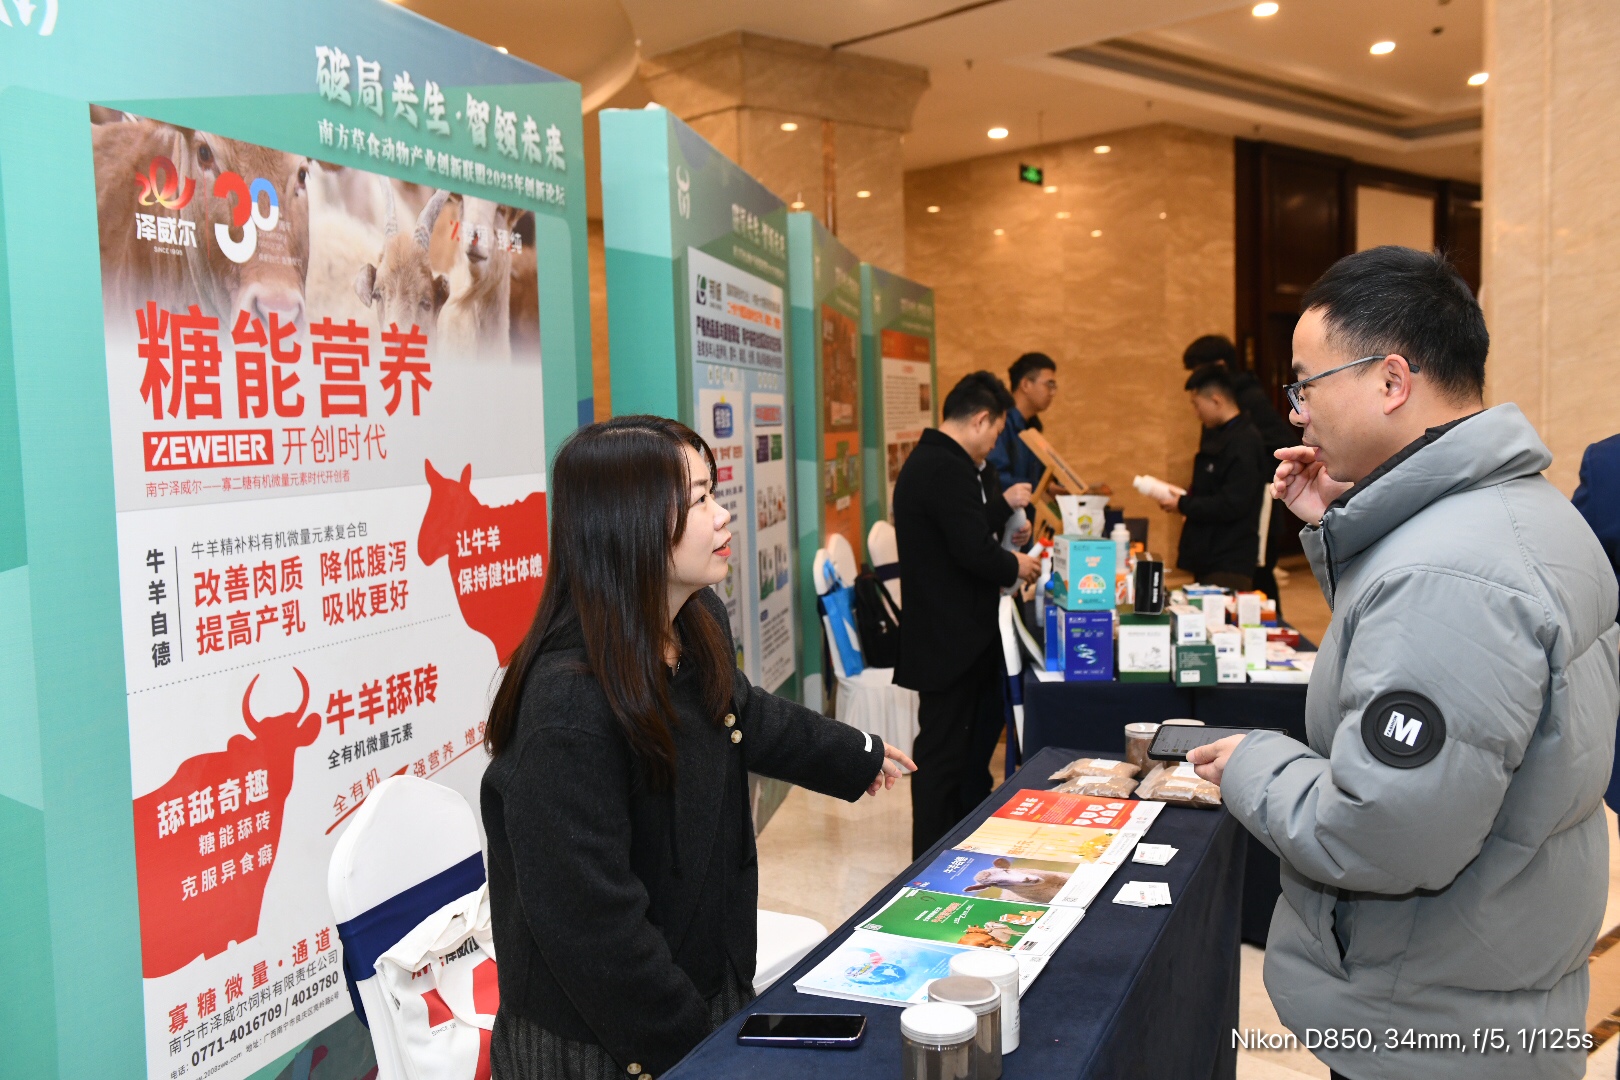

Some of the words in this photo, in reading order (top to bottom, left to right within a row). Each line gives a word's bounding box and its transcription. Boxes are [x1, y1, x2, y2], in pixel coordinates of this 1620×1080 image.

[315, 45, 566, 171] 破局共生·智领未来
[317, 118, 566, 206] 南方草食动物产业创新联盟2025年创新论坛
[135, 212, 197, 248] 泽威尔
[135, 301, 433, 420] 糖能营养
[150, 434, 268, 466] ZEWEIER
[282, 424, 387, 465] 开创时代
[191, 521, 368, 560] 牛羊精补料有机微量元素复合包
[193, 555, 304, 608] 改善肉质
[320, 540, 407, 587] 降低腹泻
[456, 525, 501, 557] 让牛羊
[457, 553, 543, 596] 保持健壮体魄
[145, 548, 171, 668] 牛羊自德
[195, 599, 306, 656] 提高产乳
[322, 579, 409, 627] 吸收更好
[326, 663, 438, 736] 牛羊舔砖
[1383, 710, 1423, 747] M
[327, 722, 413, 770] 全有机微量元素
[332, 767, 381, 817] 全有机
[413, 740, 454, 779] 强营养
[157, 768, 269, 839] 舔舐奇趣
[198, 810, 271, 857] 糖能舔砖
[181, 843, 273, 901] 克服异食癖
[168, 949, 338, 1057] 南宁市泽威尔饲料有限责任公司
[191, 1004, 282, 1067] 0771-4016709
[291, 970, 339, 1008] 4019780
